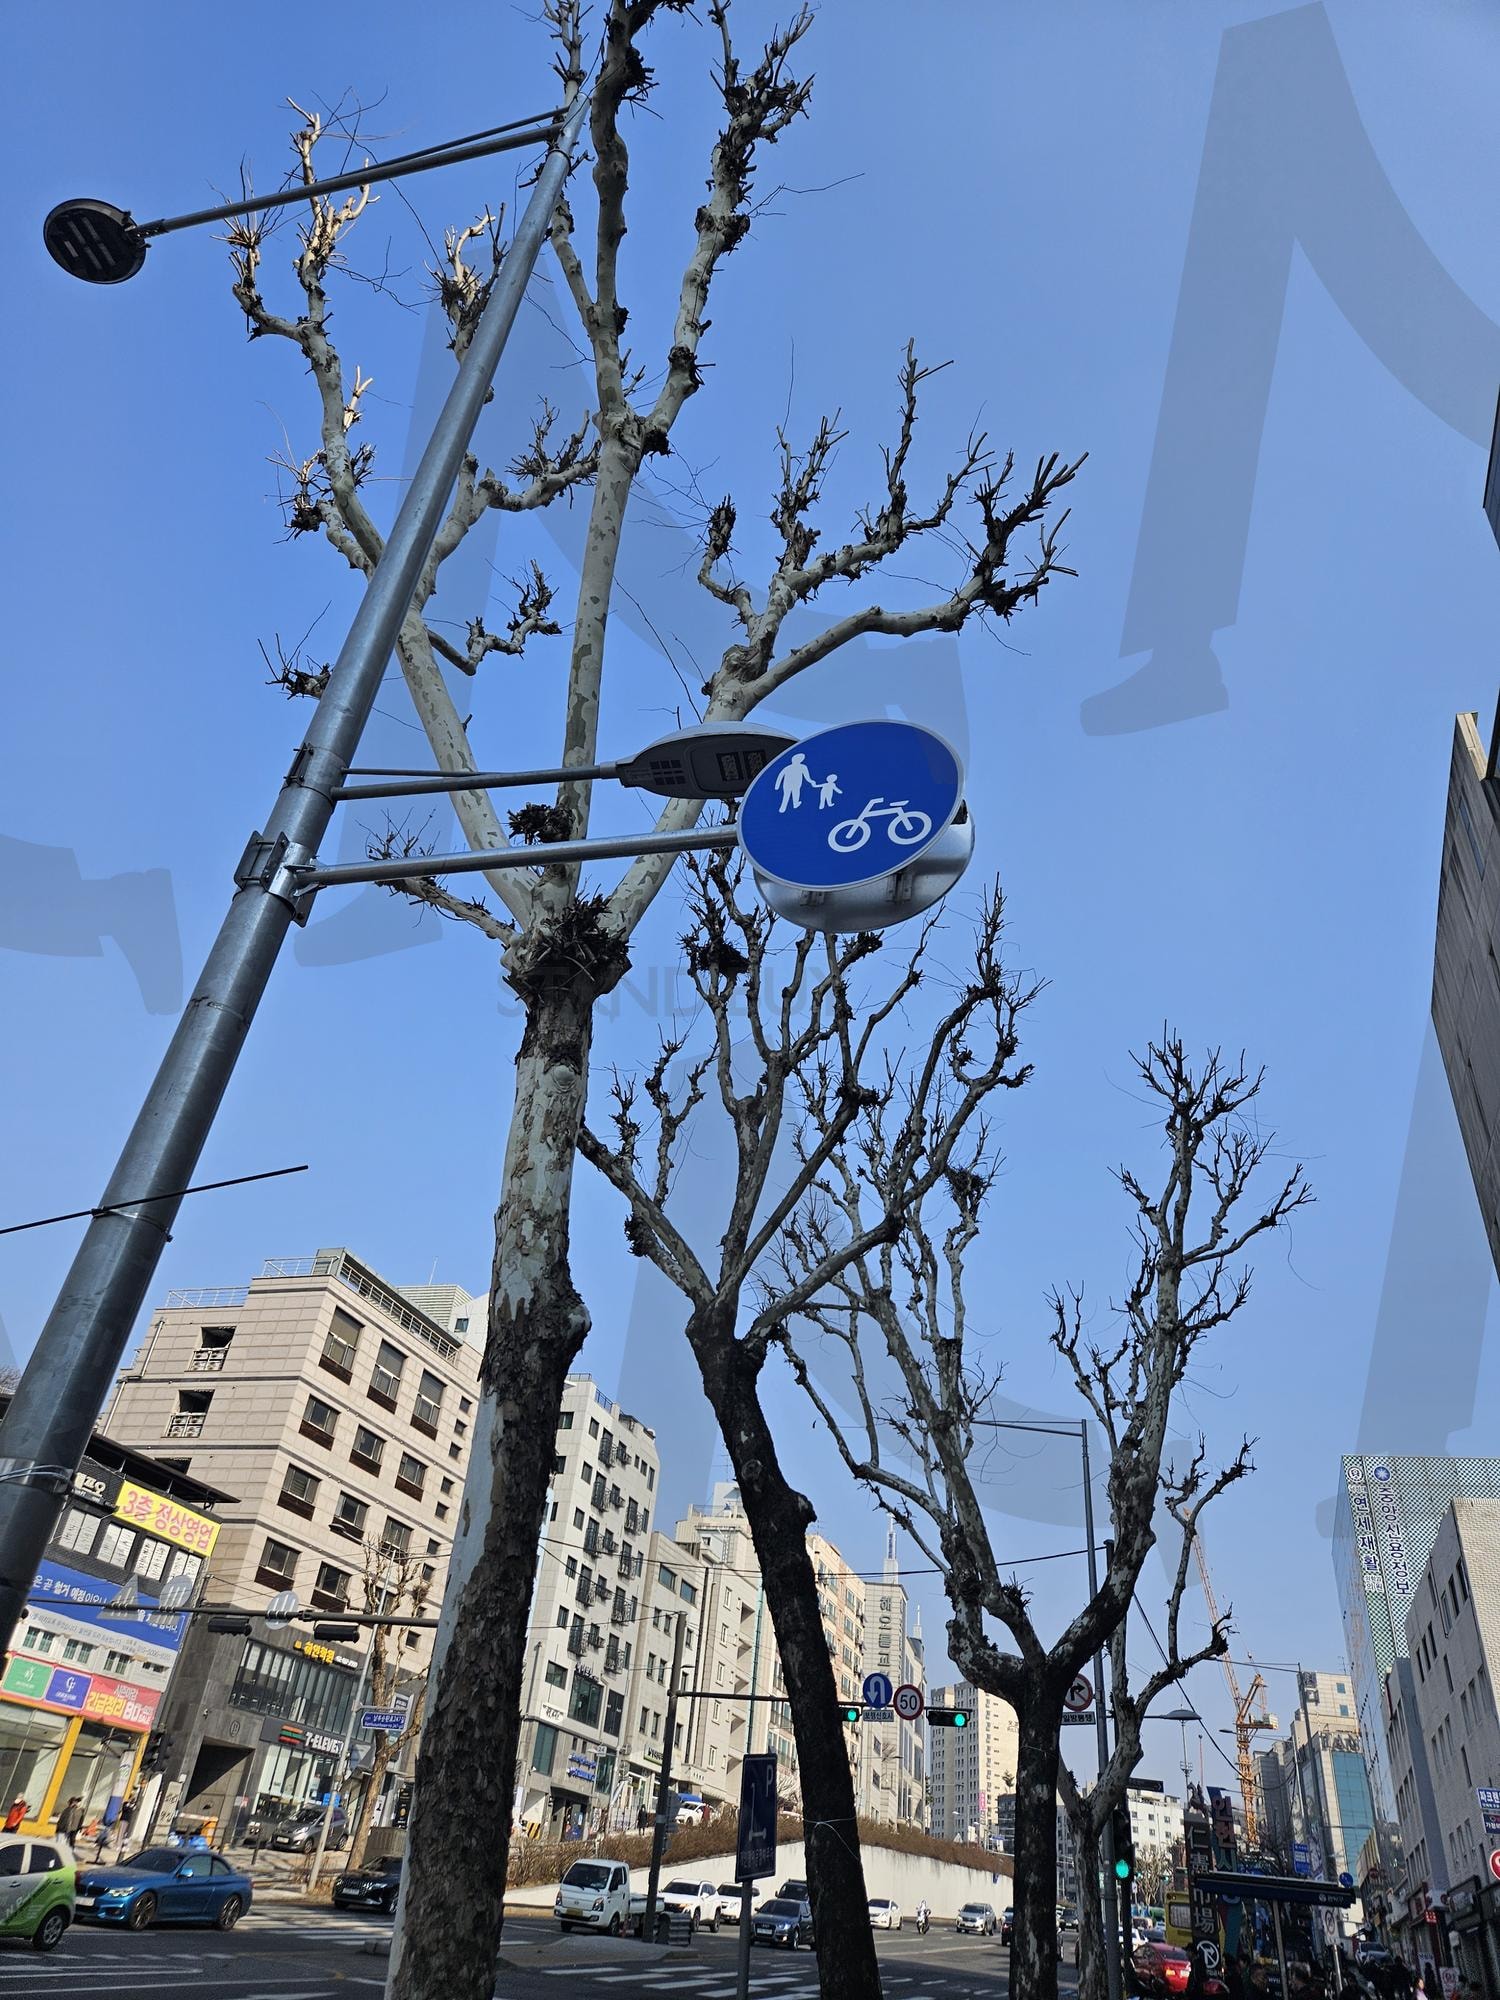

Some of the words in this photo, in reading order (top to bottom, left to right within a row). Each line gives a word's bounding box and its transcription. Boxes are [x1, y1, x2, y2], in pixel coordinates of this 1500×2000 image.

[123, 1490, 154, 1522] 3층
[154, 1502, 215, 1550] 정상영업
[1353, 1496, 1379, 1571] 연세재활
[1379, 1487, 1412, 1596] 중앙신용정보
[899, 1694, 918, 1711] 50
